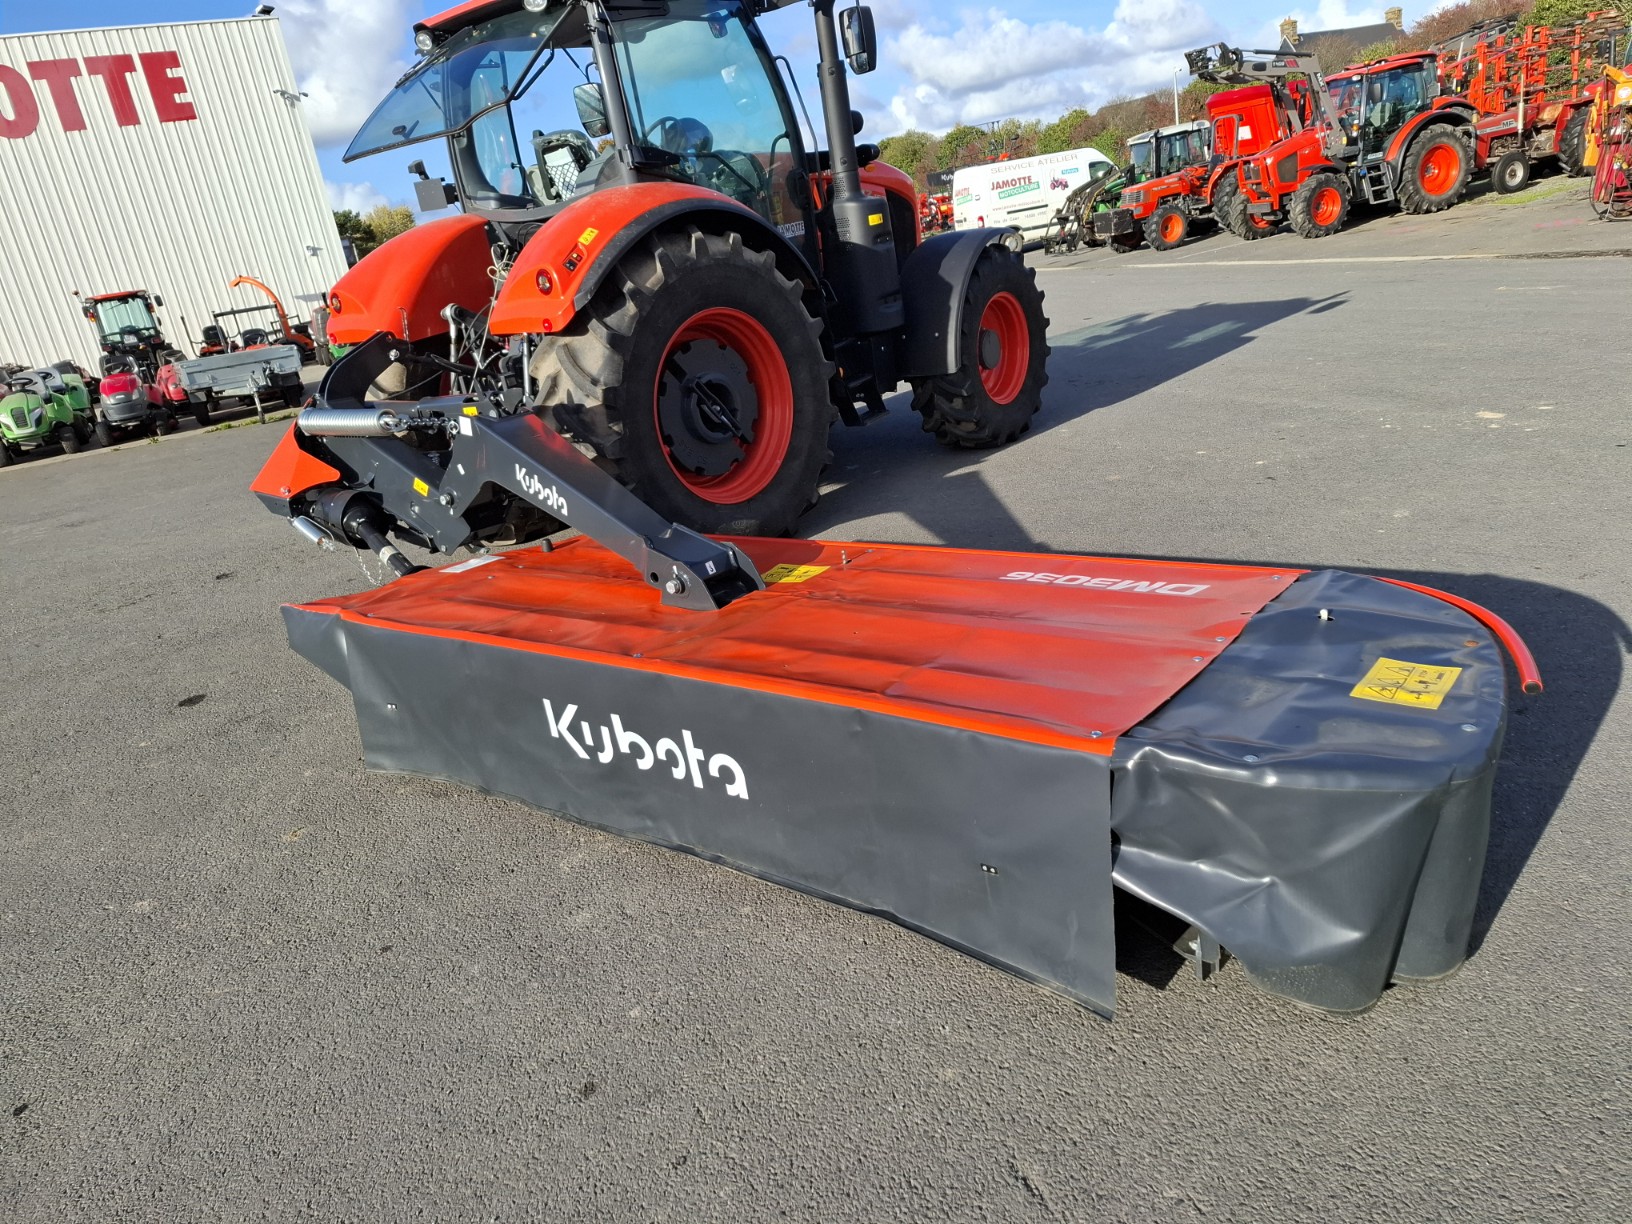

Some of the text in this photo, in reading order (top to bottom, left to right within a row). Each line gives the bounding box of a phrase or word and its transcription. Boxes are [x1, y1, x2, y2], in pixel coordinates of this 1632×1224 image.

[0, 51, 197, 139] OTTE
[1502, 120, 1514, 128] MF
[991, 153, 1078, 174] SERVICE ATELIER
[991, 175, 1033, 191] JAMOTTE
[999, 182, 1039, 198] MOTOCULTURE
[515, 463, 568, 516] Kubota
[998, 571, 1211, 596] DM3036
[542, 698, 749, 800] Kubota
